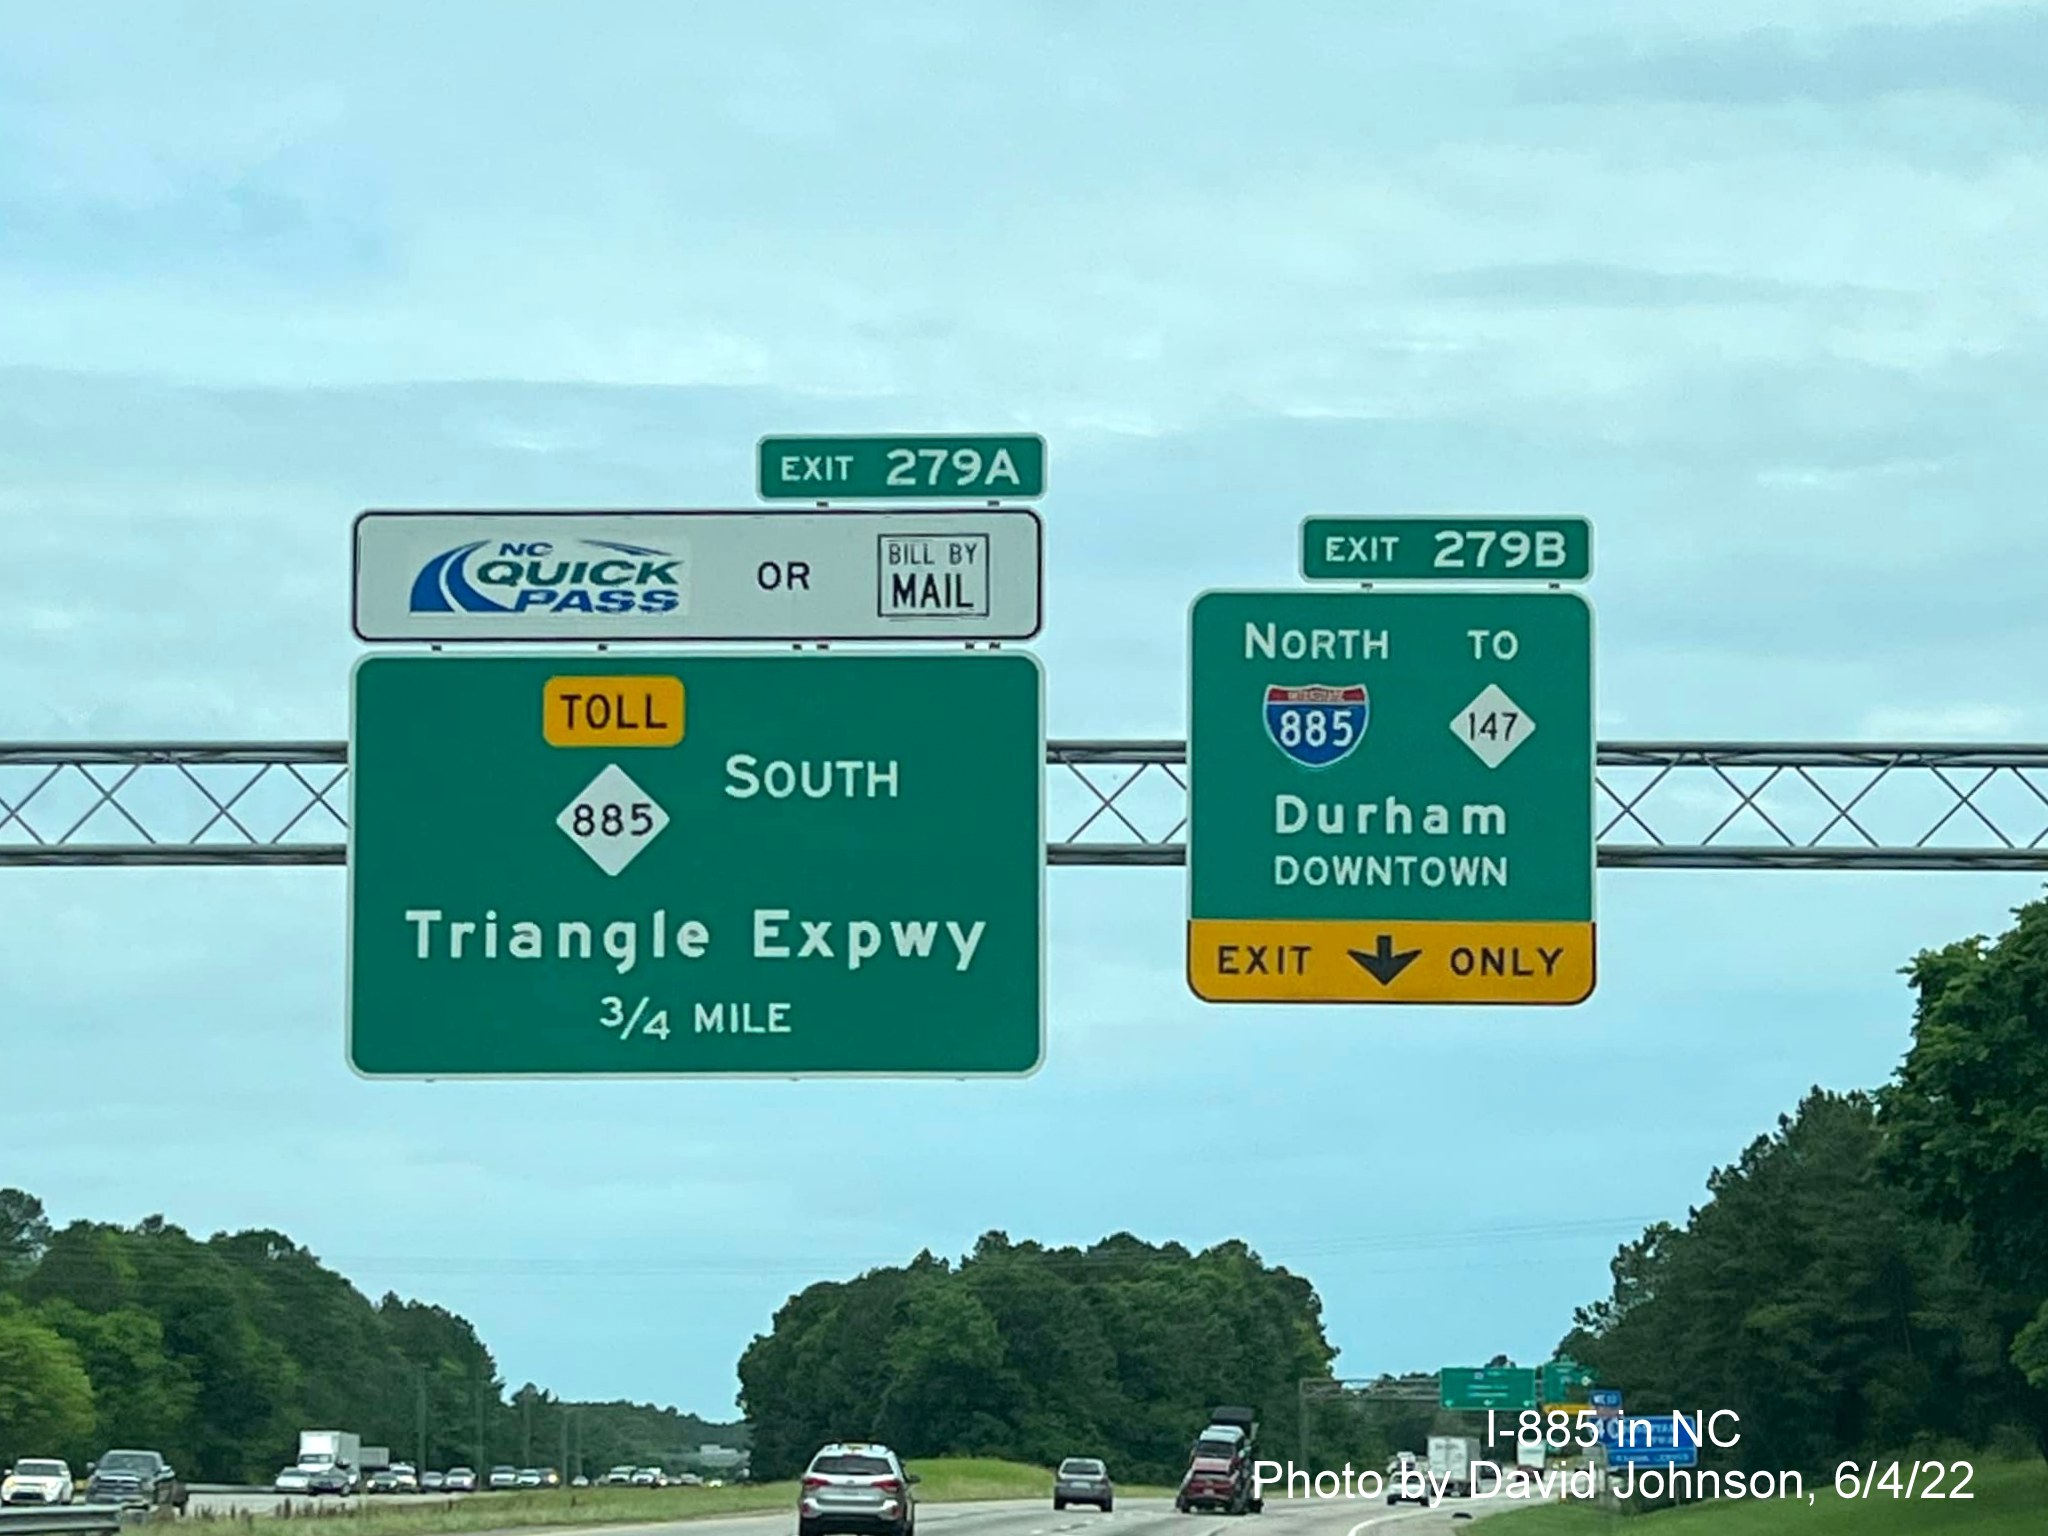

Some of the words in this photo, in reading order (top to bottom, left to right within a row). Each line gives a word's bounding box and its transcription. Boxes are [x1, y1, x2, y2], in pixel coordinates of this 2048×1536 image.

[781, 456, 853, 482] EXIT
[886, 450, 1020, 486] 279A
[499, 542, 553, 556] NC
[888, 543, 935, 565] BILL
[949, 543, 977, 565] BY
[1326, 536, 1399, 562] EXIT
[1434, 531, 1567, 568] 279B
[477, 560, 684, 587] QUICK
[757, 561, 810, 590] OR
[892, 573, 974, 608] MAIL
[514, 589, 679, 613] PASS
[1245, 623, 1389, 660] NORTH
[1467, 630, 1519, 660] TO
[561, 695, 667, 730] TOLL
[1280, 710, 1353, 747] 885
[1468, 712, 1519, 741] 147
[725, 754, 898, 799] SOUTH
[572, 804, 654, 837] 885
[1275, 795, 1507, 835] Durham
[1274, 857, 1507, 886] DOWNTOWN
[406, 910, 710, 973] Triangle
[754, 910, 986, 971] Expwy
[1218, 947, 1312, 974] EXIT
[1450, 948, 1564, 976] ONLY
[600, 996, 671, 1041] 3/4
[694, 1003, 792, 1034] MILE
